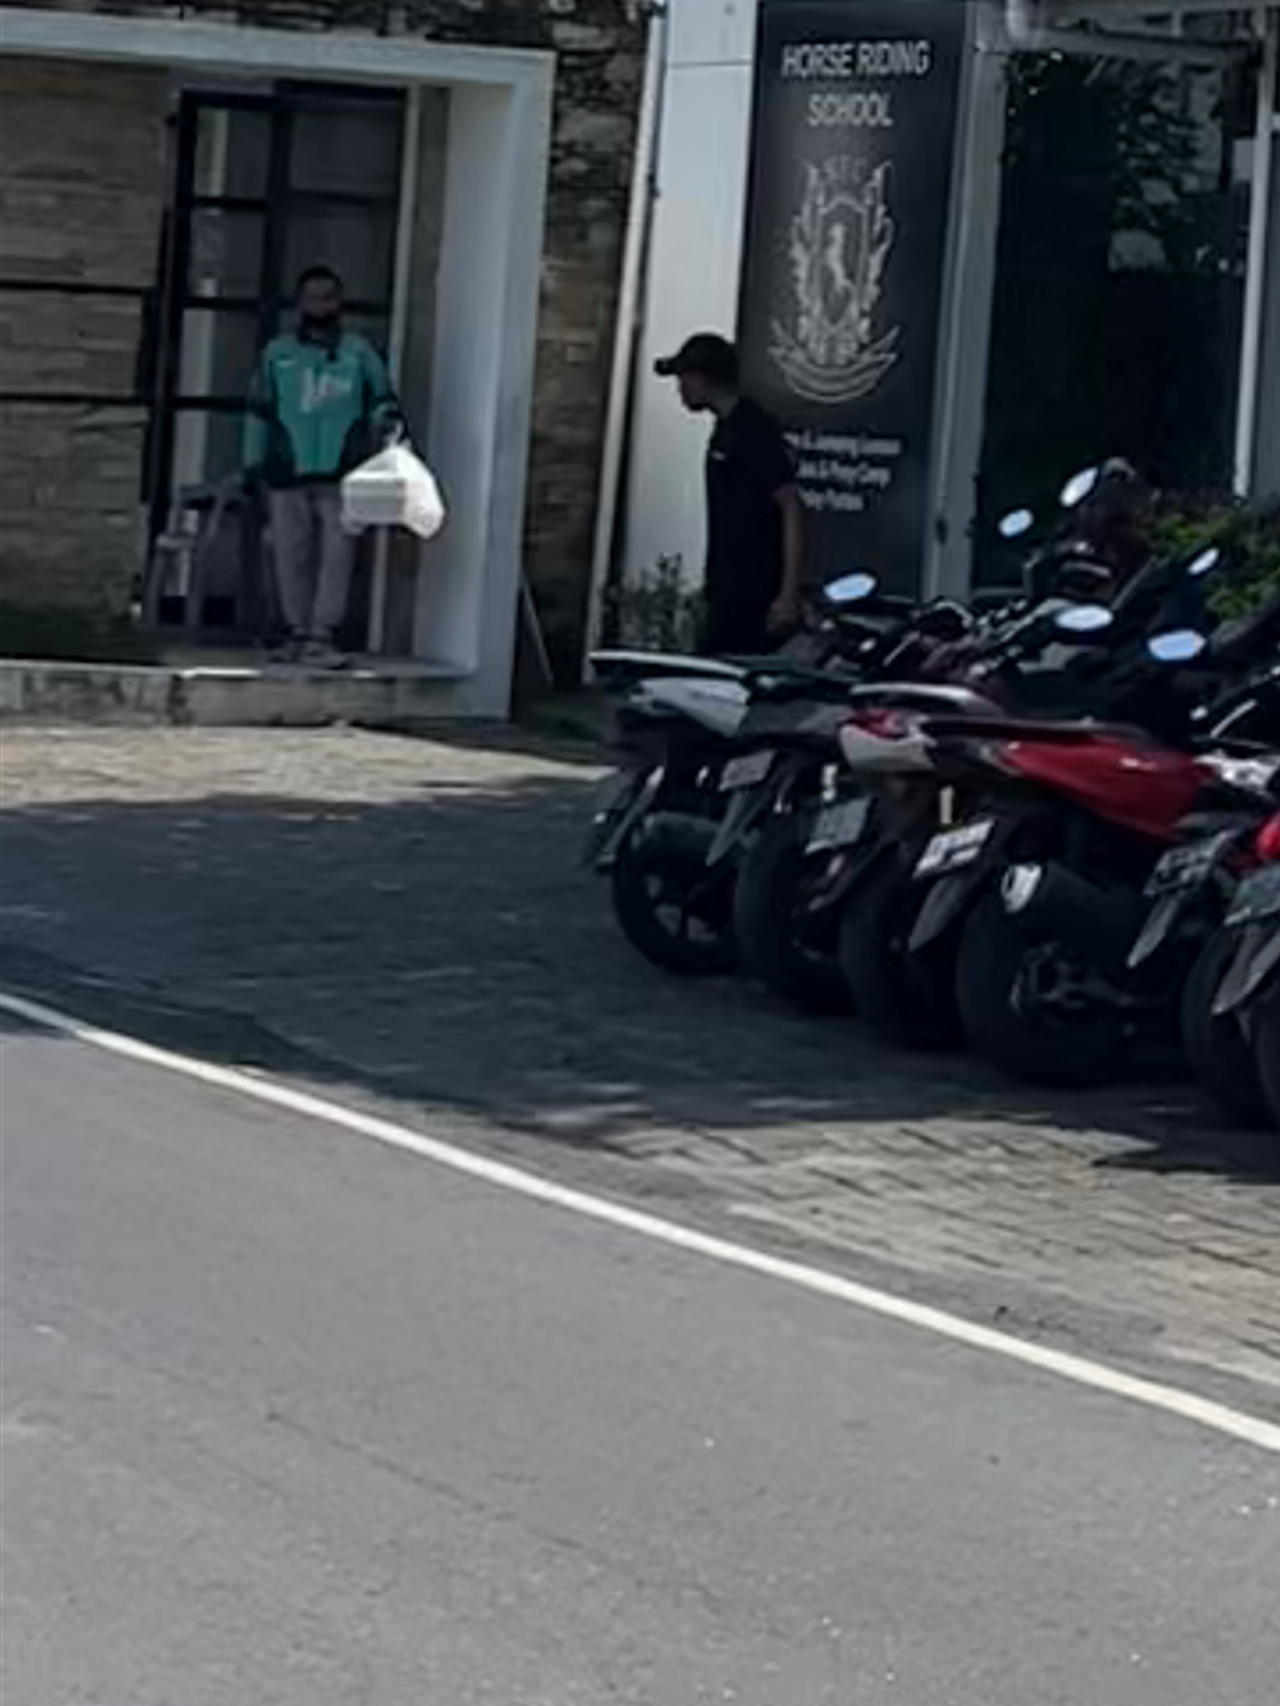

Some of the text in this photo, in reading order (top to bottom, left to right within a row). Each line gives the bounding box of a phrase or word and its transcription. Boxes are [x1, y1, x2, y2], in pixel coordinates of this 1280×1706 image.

[781, 40, 930, 77] HORSE RIDING
[808, 92, 893, 127] SCHOOL
